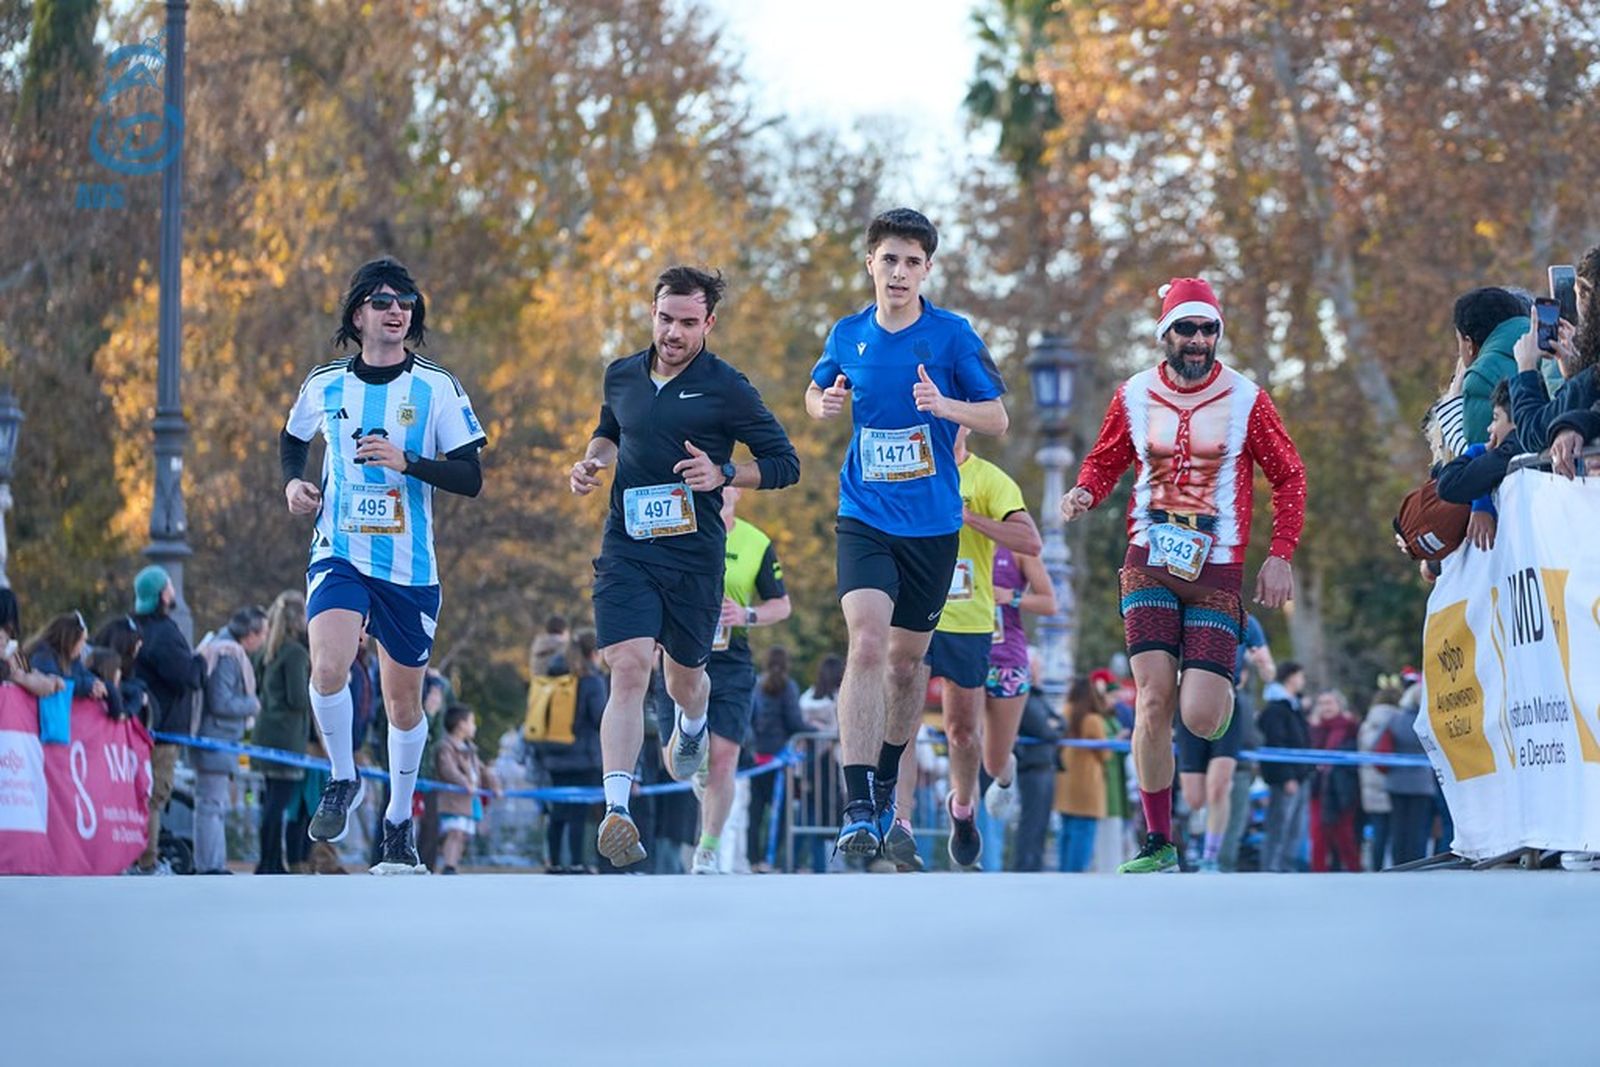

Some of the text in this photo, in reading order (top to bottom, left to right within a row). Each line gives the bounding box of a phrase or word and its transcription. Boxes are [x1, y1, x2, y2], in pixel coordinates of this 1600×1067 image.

[876, 443, 915, 462] 1471
[357, 499, 387, 516] 495
[644, 500, 672, 518] 497
[1159, 535, 1193, 560] 1343
[1527, 738, 1567, 772] Deportes
